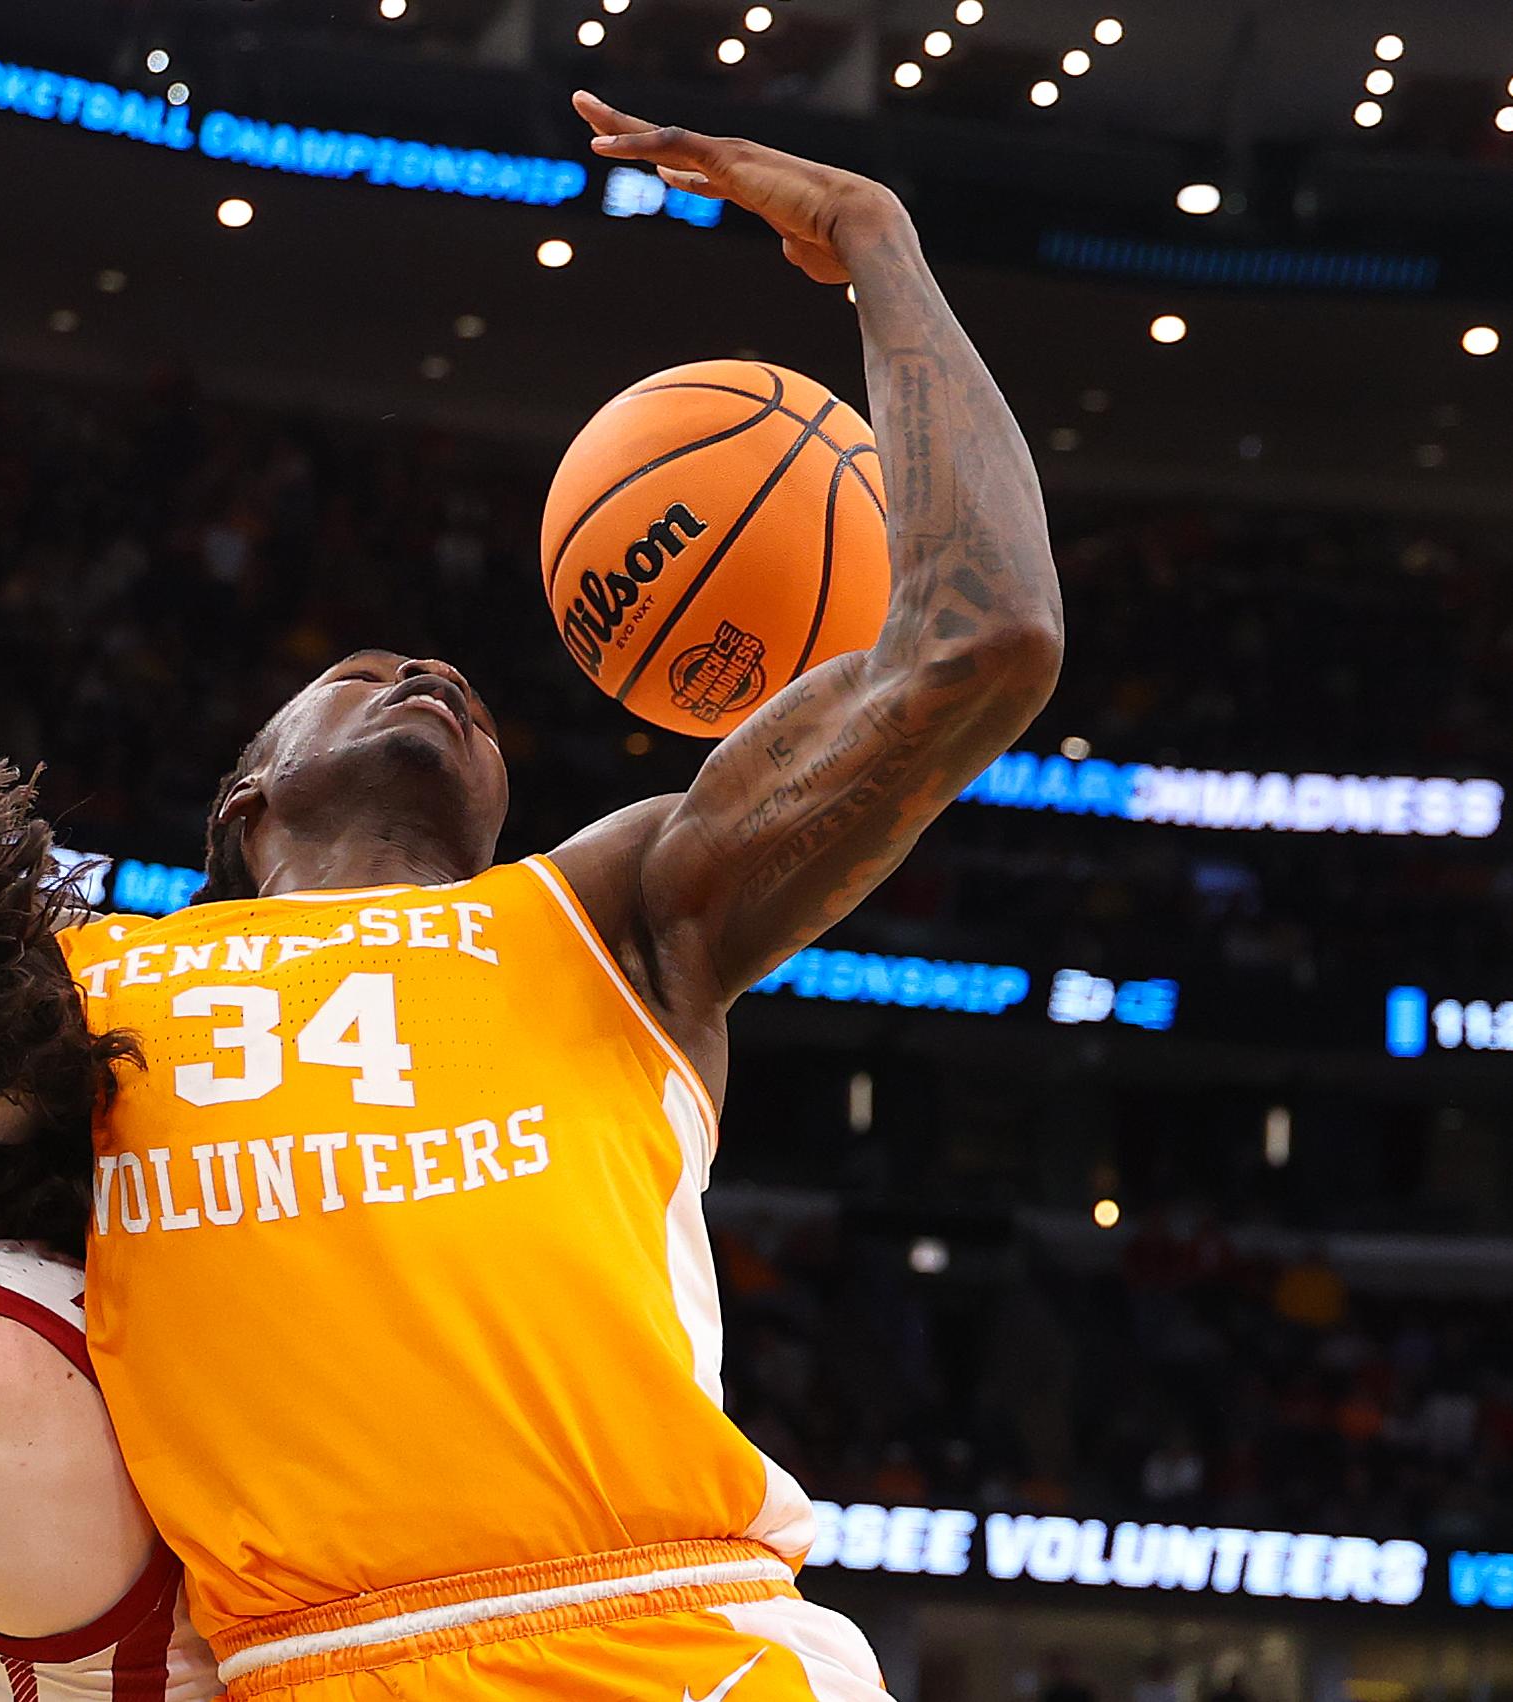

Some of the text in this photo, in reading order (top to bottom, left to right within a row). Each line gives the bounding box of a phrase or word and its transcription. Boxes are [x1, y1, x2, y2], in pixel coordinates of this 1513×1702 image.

[199, 110, 587, 207] CHAMPIONSHIP
[563, 501, 709, 679] Wilson
[632, 594, 656, 624] NXT
[683, 651, 727, 702] MARCH
[704, 634, 761, 706] MADNESS
[171, 972, 416, 1108] 34
[92, 1104, 551, 1236] VOLUNTEERS
[984, 1512, 1428, 1606] VOLUNTEERS
